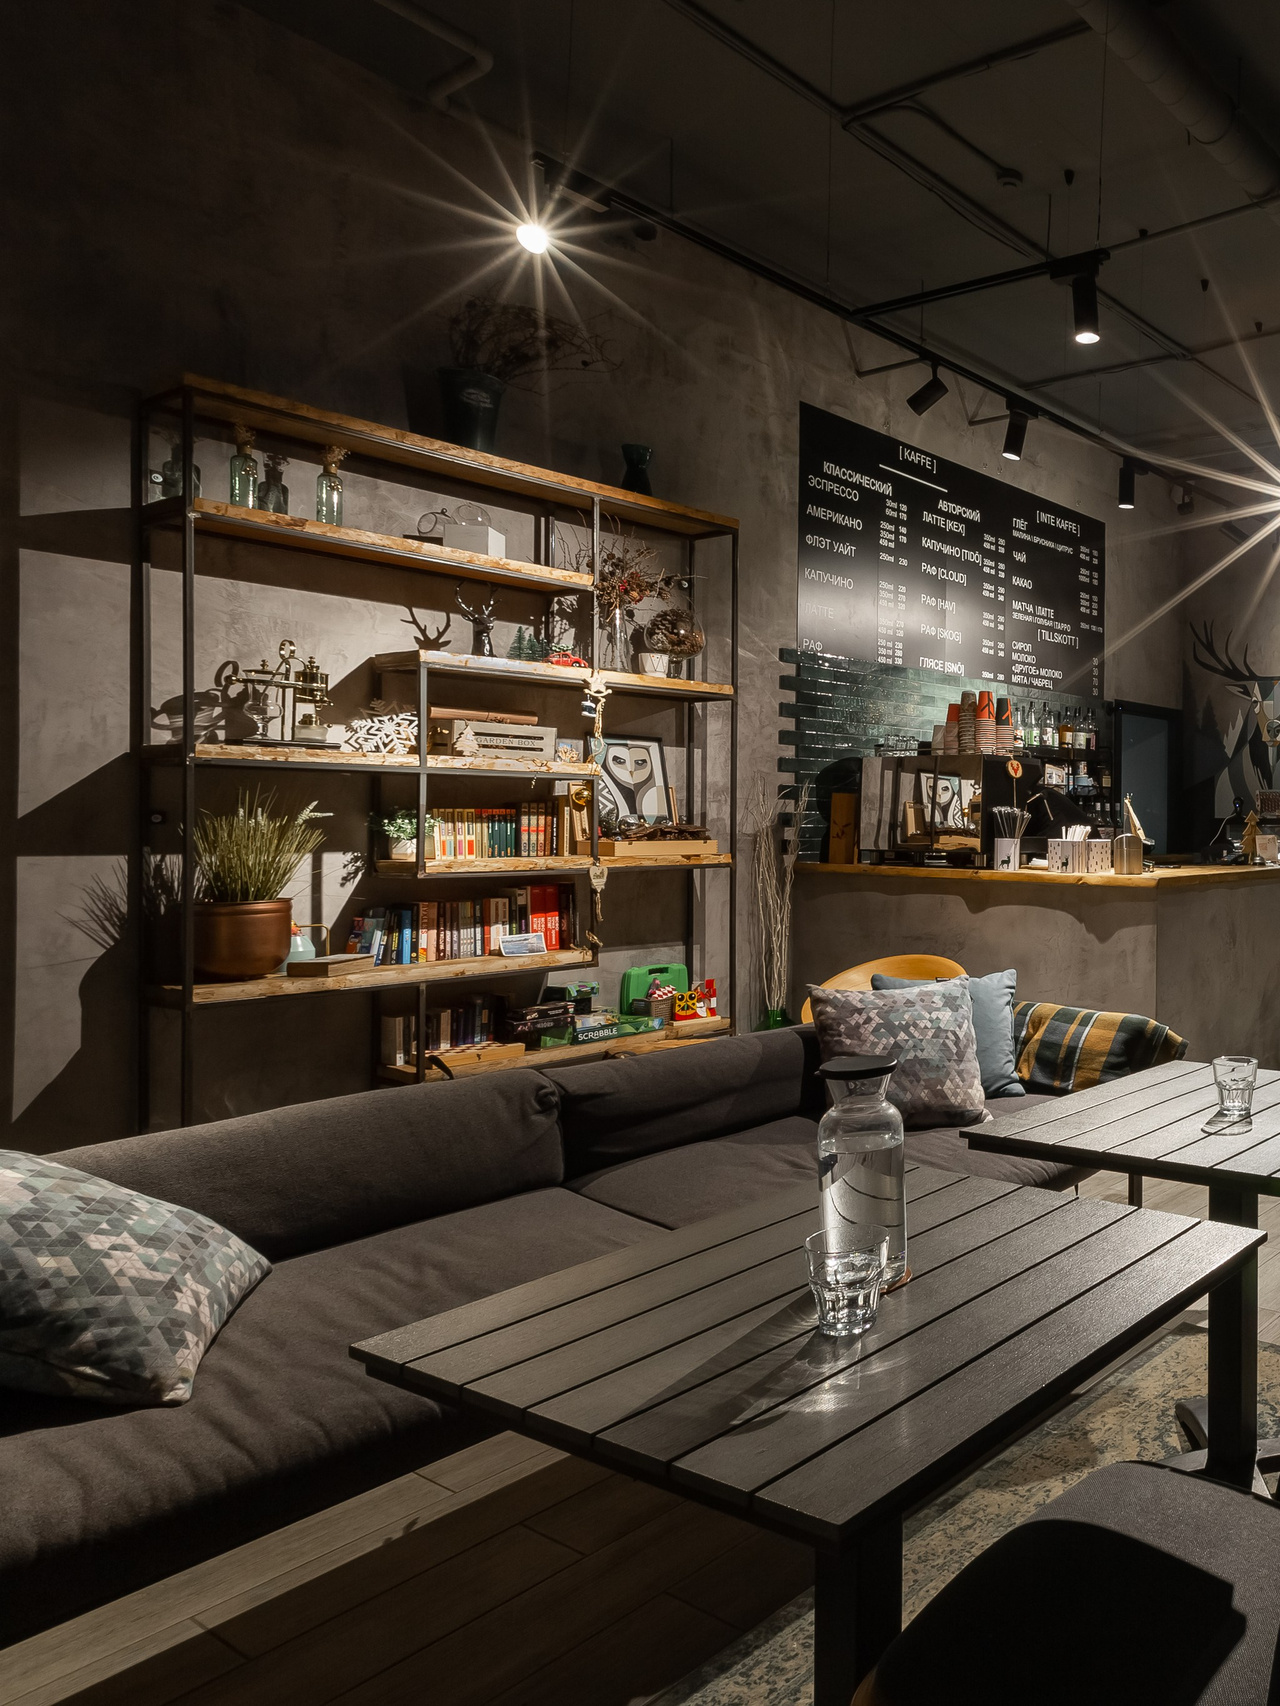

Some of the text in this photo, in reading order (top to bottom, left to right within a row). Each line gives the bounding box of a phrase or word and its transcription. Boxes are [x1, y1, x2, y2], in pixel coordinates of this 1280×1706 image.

[904, 448, 932, 469] KAFFE
[823, 461, 892, 496] КЛАССИЧЕСКИЙ
[808, 475, 859, 502] ЭСПРЕССО
[806, 504, 863, 531] АМЕРИКАНО
[938, 499, 980, 522] АВТОРСКИЙ
[880, 521, 895, 532] 250ml
[923, 511, 945, 529] ЛАТТЕ
[1040, 512, 1055, 527] INTE
[1056, 517, 1077, 534] KAFFE
[880, 530, 895, 540] 350ml
[805, 534, 856, 558] ФЛЭТ УАЙТ
[921, 536, 960, 557] КАПУЧИНО
[880, 552, 895, 563] 250ml
[1012, 551, 1027, 563] ЧАЙ
[804, 567, 854, 590] КАПУЧИНО
[921, 563, 967, 586] РАФ [CLOUD]
[1012, 575, 1033, 590] КАКАО
[804, 602, 834, 619] ЛАТТЕ
[921, 594, 955, 614] РАФ [HAV]
[1012, 600, 1034, 614] МАТЧА
[921, 623, 961, 644] РАФ [SKOG]
[1041, 629, 1075, 646] TILLSKOTT
[802, 638, 823, 652] РАФ
[1012, 640, 1032, 652] СИРОП
[919, 656, 944, 671] ГЛЯСЕ
[1012, 652, 1036, 664] МОЛОКО
[1012, 674, 1027, 684] МЯТА
[1031, 677, 1053, 690] ЧАБРЕЦ
[1040, 668, 1063, 679] МОЛОКО
[476, 737, 536, 747] GARDEN BOX
[578, 1027, 618, 1041] SCRABBLE
